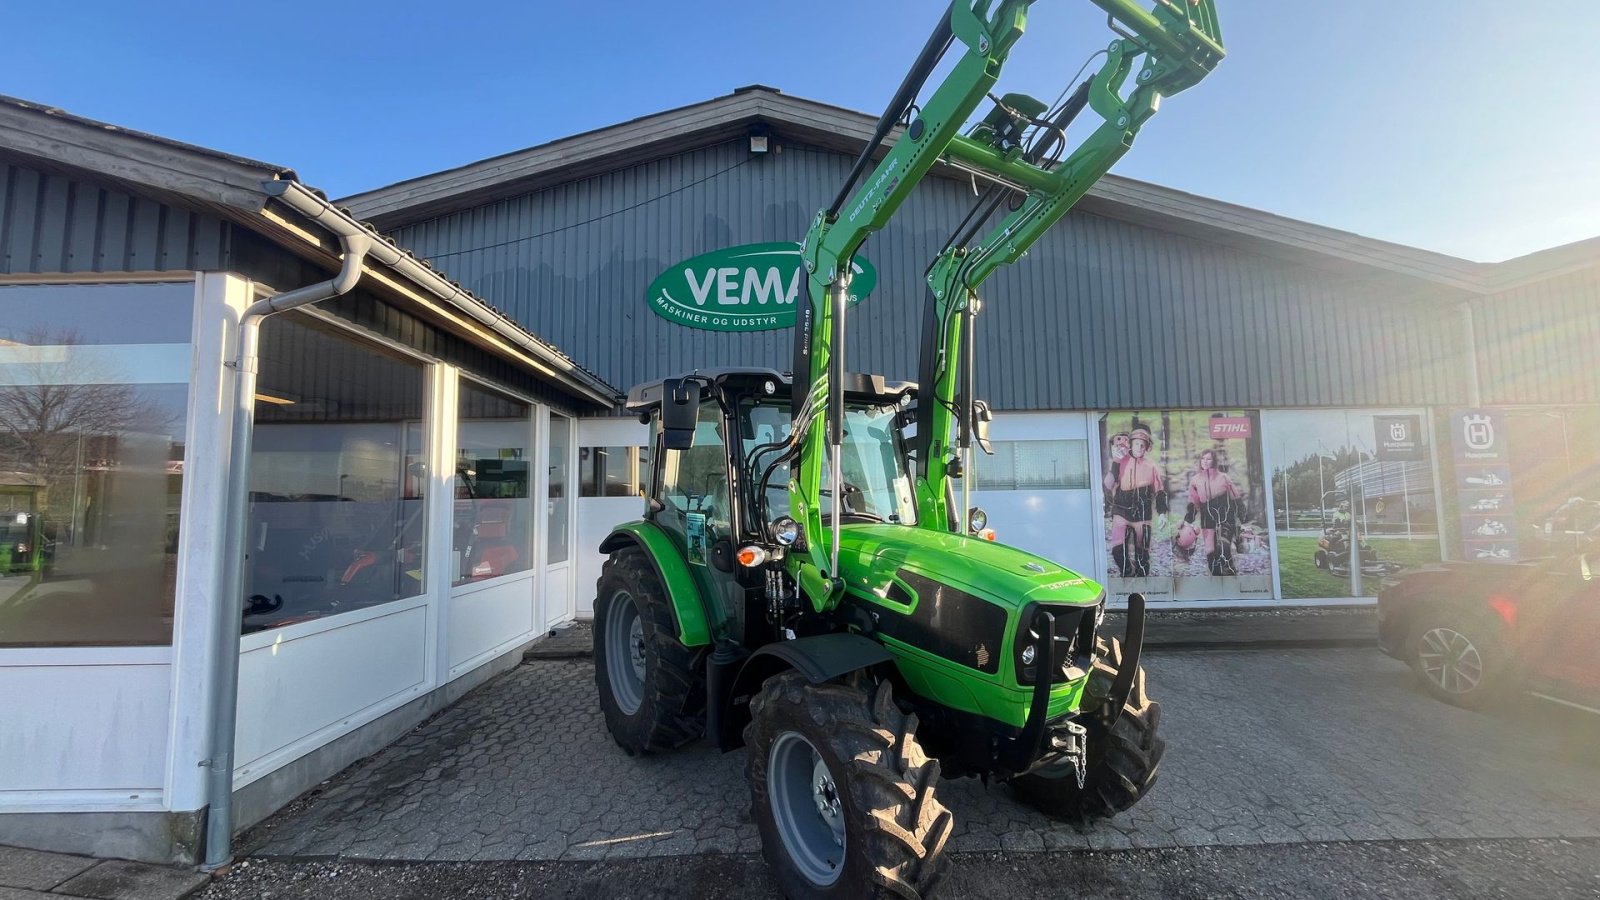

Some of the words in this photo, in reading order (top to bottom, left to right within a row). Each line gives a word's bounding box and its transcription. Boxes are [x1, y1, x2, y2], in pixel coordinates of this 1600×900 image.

[849, 158, 898, 222] DEUTZ-FAHR
[684, 266, 801, 306] VEMA
[656, 296, 708, 324] MASKINER
[712, 317, 728, 326] OG
[733, 316, 777, 326] UDSTYR
[1213, 423, 1247, 433] STIHL
